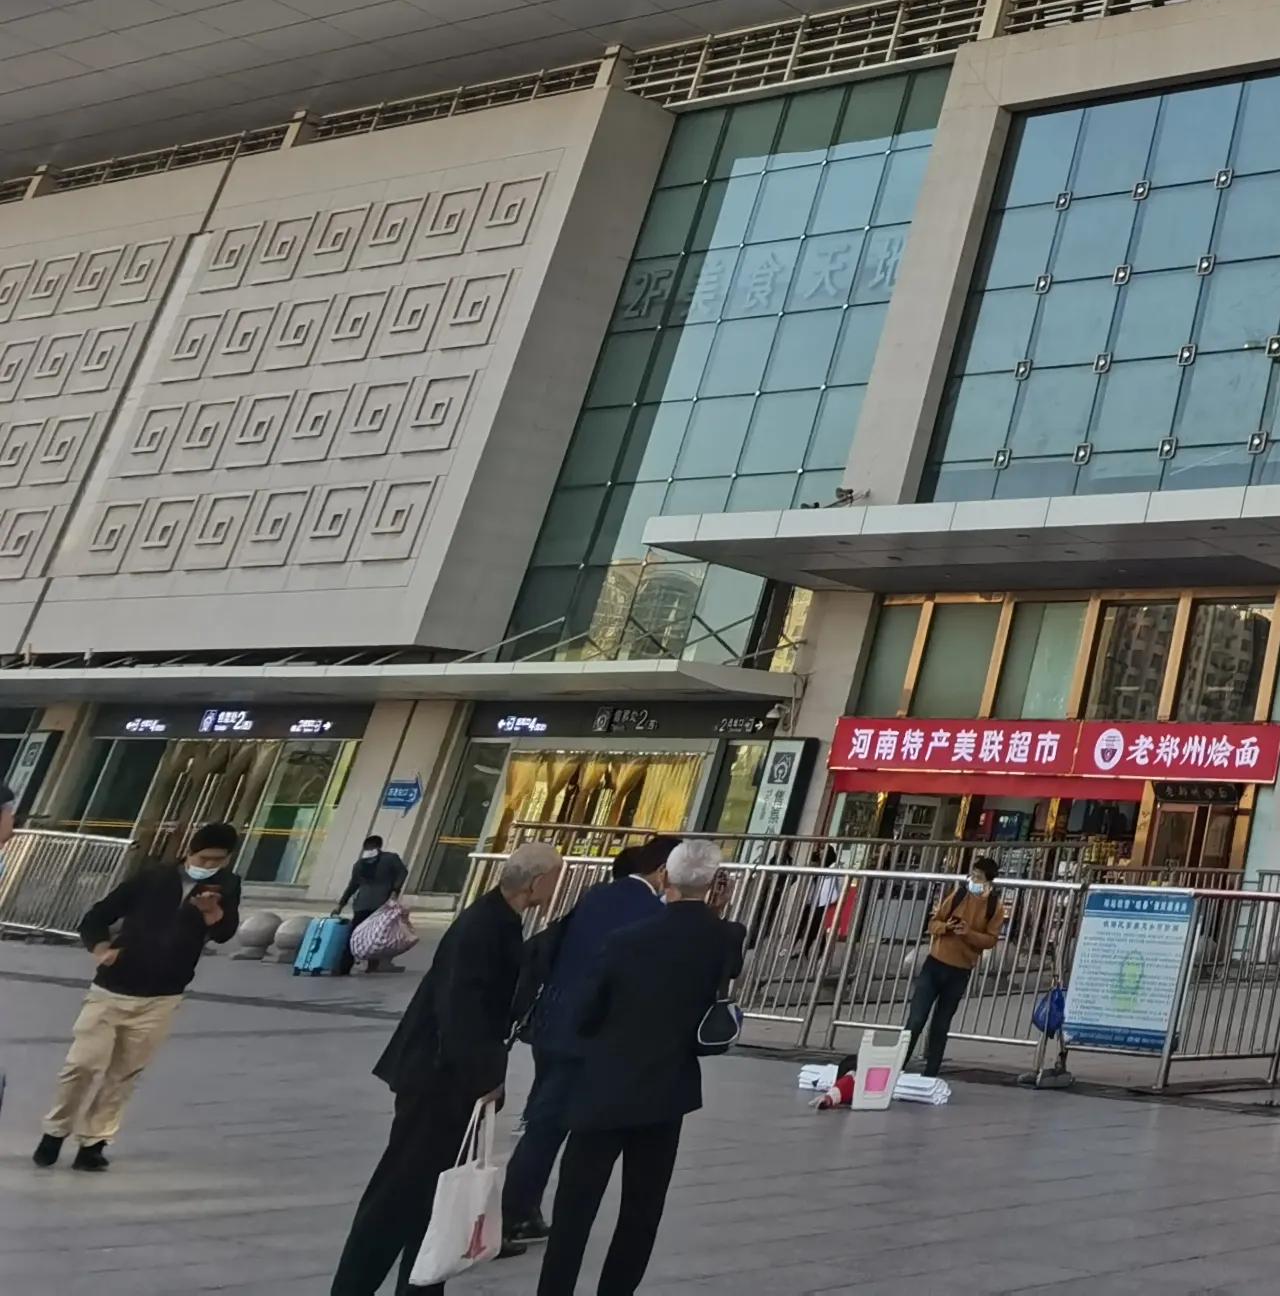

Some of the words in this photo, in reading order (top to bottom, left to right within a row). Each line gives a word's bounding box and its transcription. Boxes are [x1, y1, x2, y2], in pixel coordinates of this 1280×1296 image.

[847, 727, 1061, 765] 河南特产美联超市
[1126, 732, 1261, 768] 老郑州烩面
